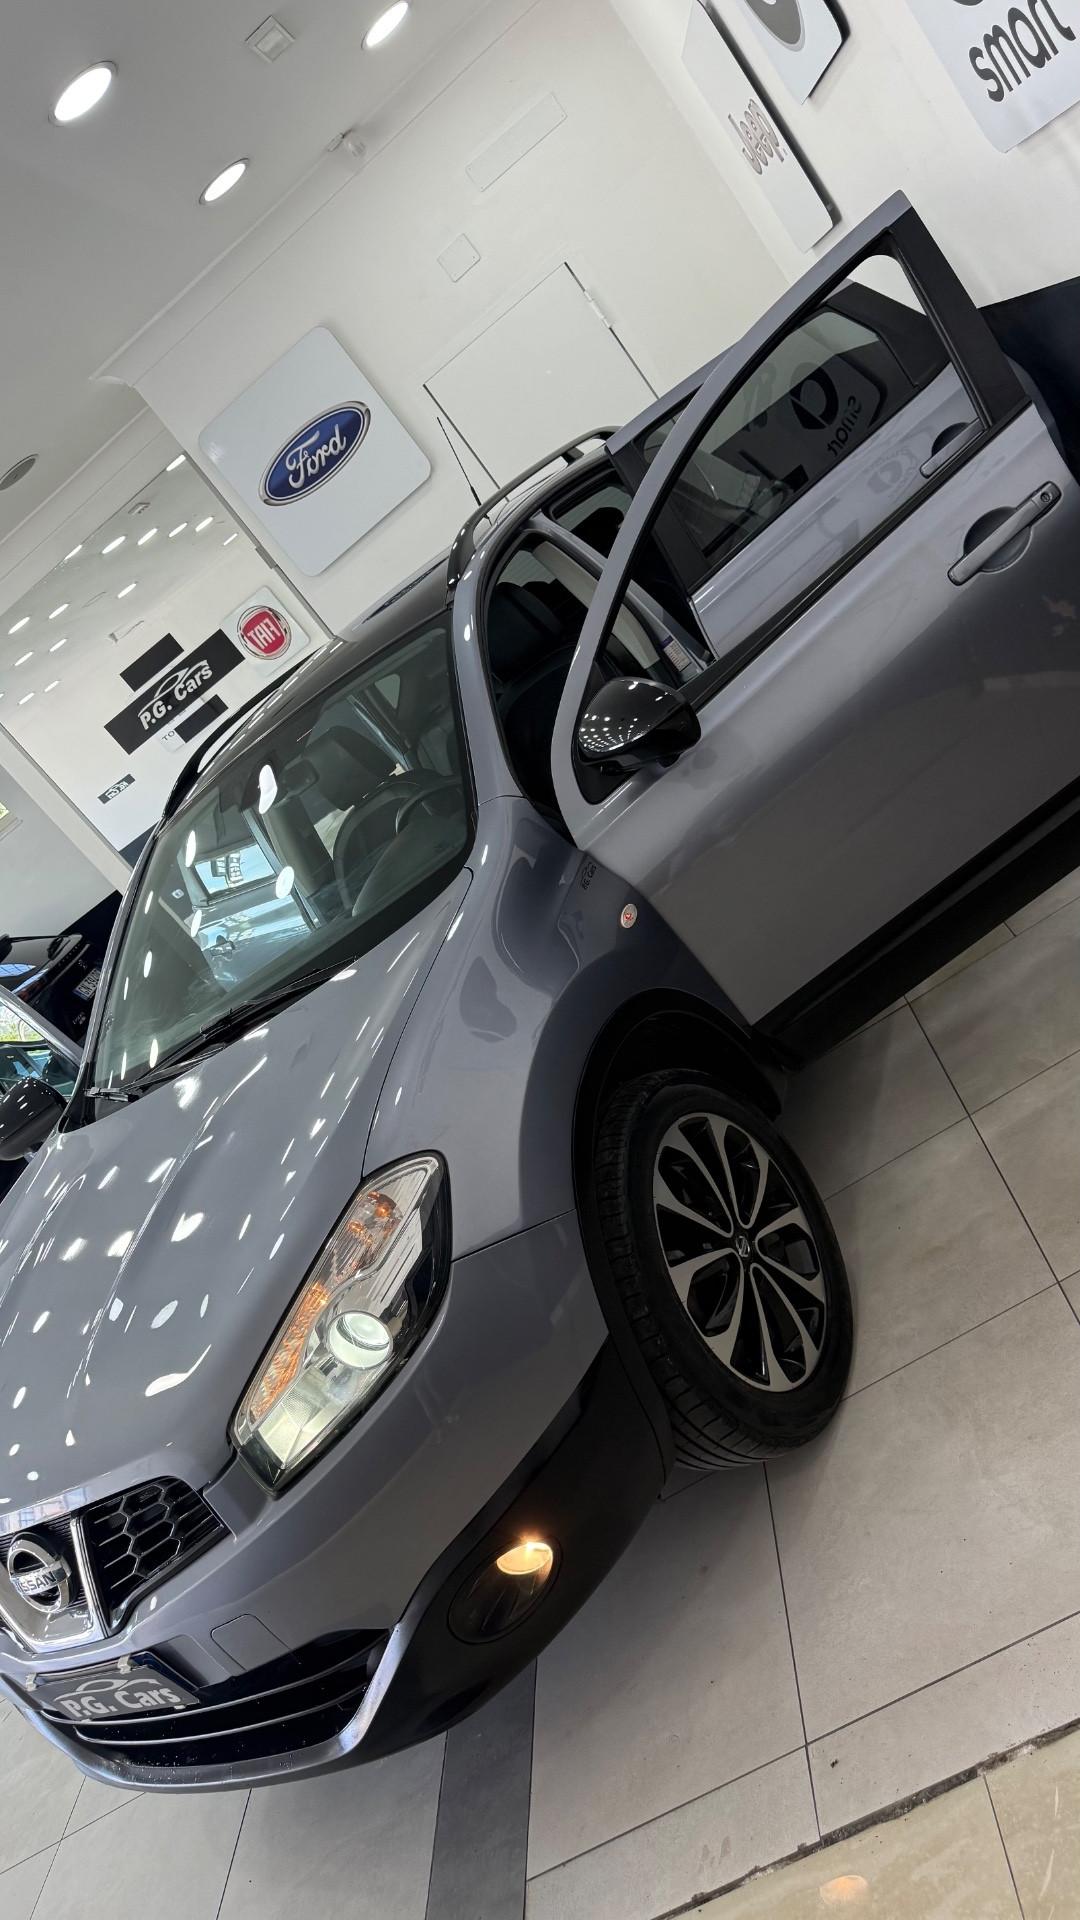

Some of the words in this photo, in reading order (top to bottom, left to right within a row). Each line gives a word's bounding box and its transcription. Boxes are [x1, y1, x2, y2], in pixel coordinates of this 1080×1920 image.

[286, 424, 346, 488] Ford
[140, 700, 172, 730] P.G.
[174, 666, 213, 701] Cars
[60, 1696, 118, 1717] P.G.
[114, 1688, 181, 1708] Cars
